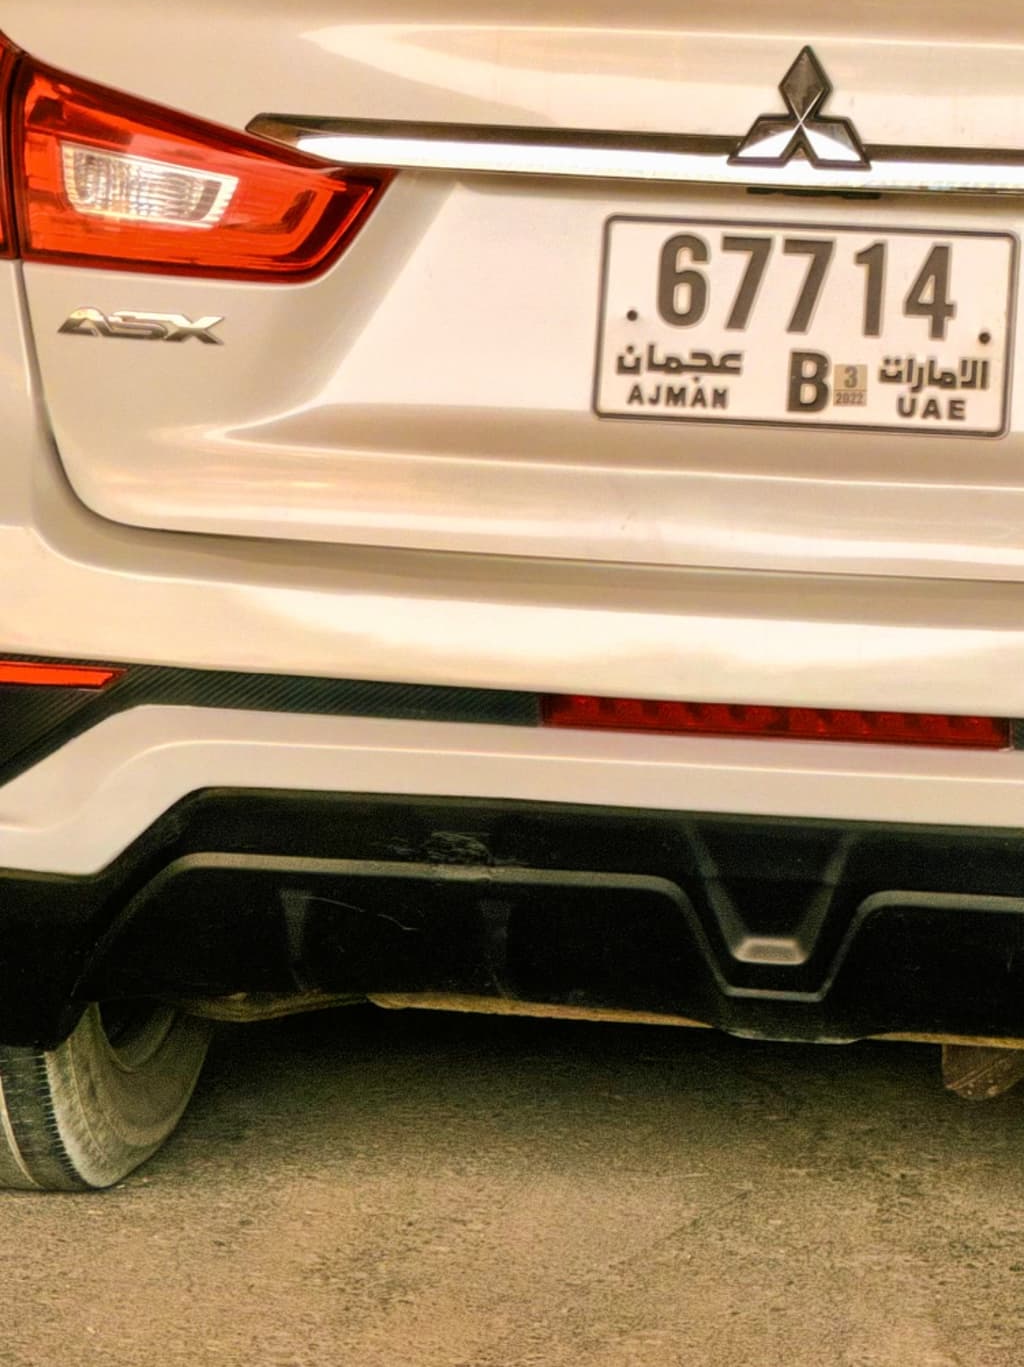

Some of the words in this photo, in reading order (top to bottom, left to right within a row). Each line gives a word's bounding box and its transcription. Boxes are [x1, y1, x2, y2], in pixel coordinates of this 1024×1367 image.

[657, 232, 956, 339] 67714
[58, 306, 224, 345] ASX
[616, 342, 743, 378] عجمان
[844, 365, 859, 388] 3
[878, 356, 990, 393] الامارات
[626, 383, 729, 410] AJMAN
[786, 350, 830, 413] B
[897, 395, 966, 421] UAE
